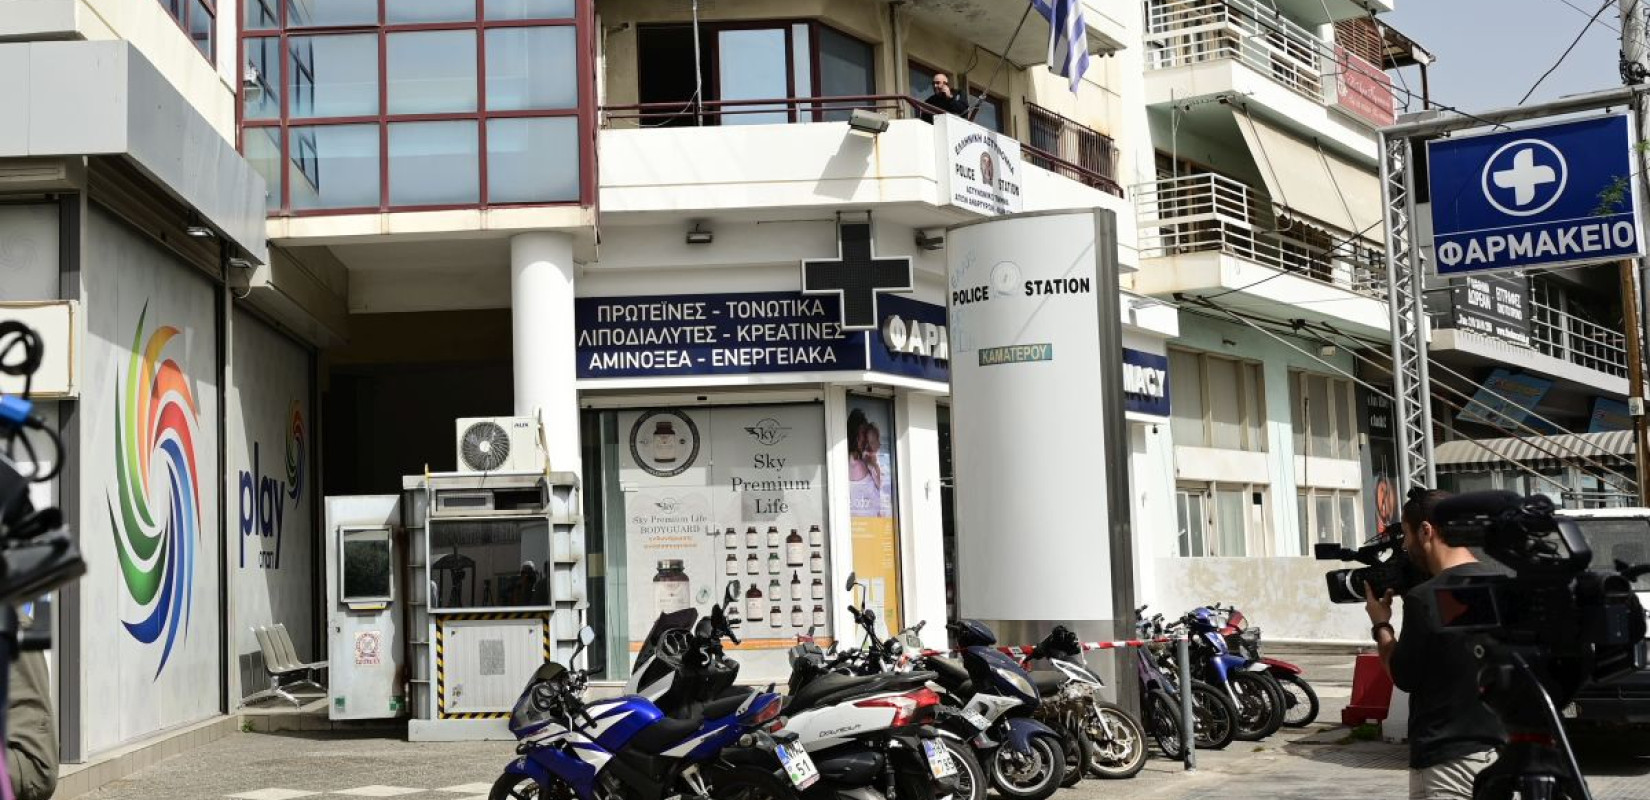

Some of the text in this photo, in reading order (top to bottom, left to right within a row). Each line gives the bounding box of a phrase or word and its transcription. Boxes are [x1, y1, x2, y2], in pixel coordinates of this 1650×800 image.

[955, 163, 1020, 196] POLICE STATION
[1438, 220, 1635, 266] ΦΑΡΜΑΚΕΙΟ
[952, 277, 1090, 306] POLICE STATION
[597, 300, 707, 322] ΠΡΩΤΕΪΝΕΣ
[726, 299, 825, 320] ΤΟΝΩΤΙΚΑ
[578, 326, 717, 347] ΛΙΠΟΔΙΑΛΥΤΕΣ
[737, 322, 846, 342] ΚΡΕΑΤΙΝΕΣ
[589, 350, 692, 370] ΑΜΙΝΟΞΕΑ
[711, 346, 837, 367] ΕΝΕΡΓΕΙΑΚΑ
[981, 344, 1048, 364] ΚΑΜΑΤΕΡΟΥ
[754, 453, 786, 472] Sky
[731, 476, 811, 492] Premium
[239, 442, 286, 569] play
[755, 498, 789, 514] Life
[632, 514, 708, 525] Sky Premium Life
[640, 525, 701, 534] BODYGUARD
